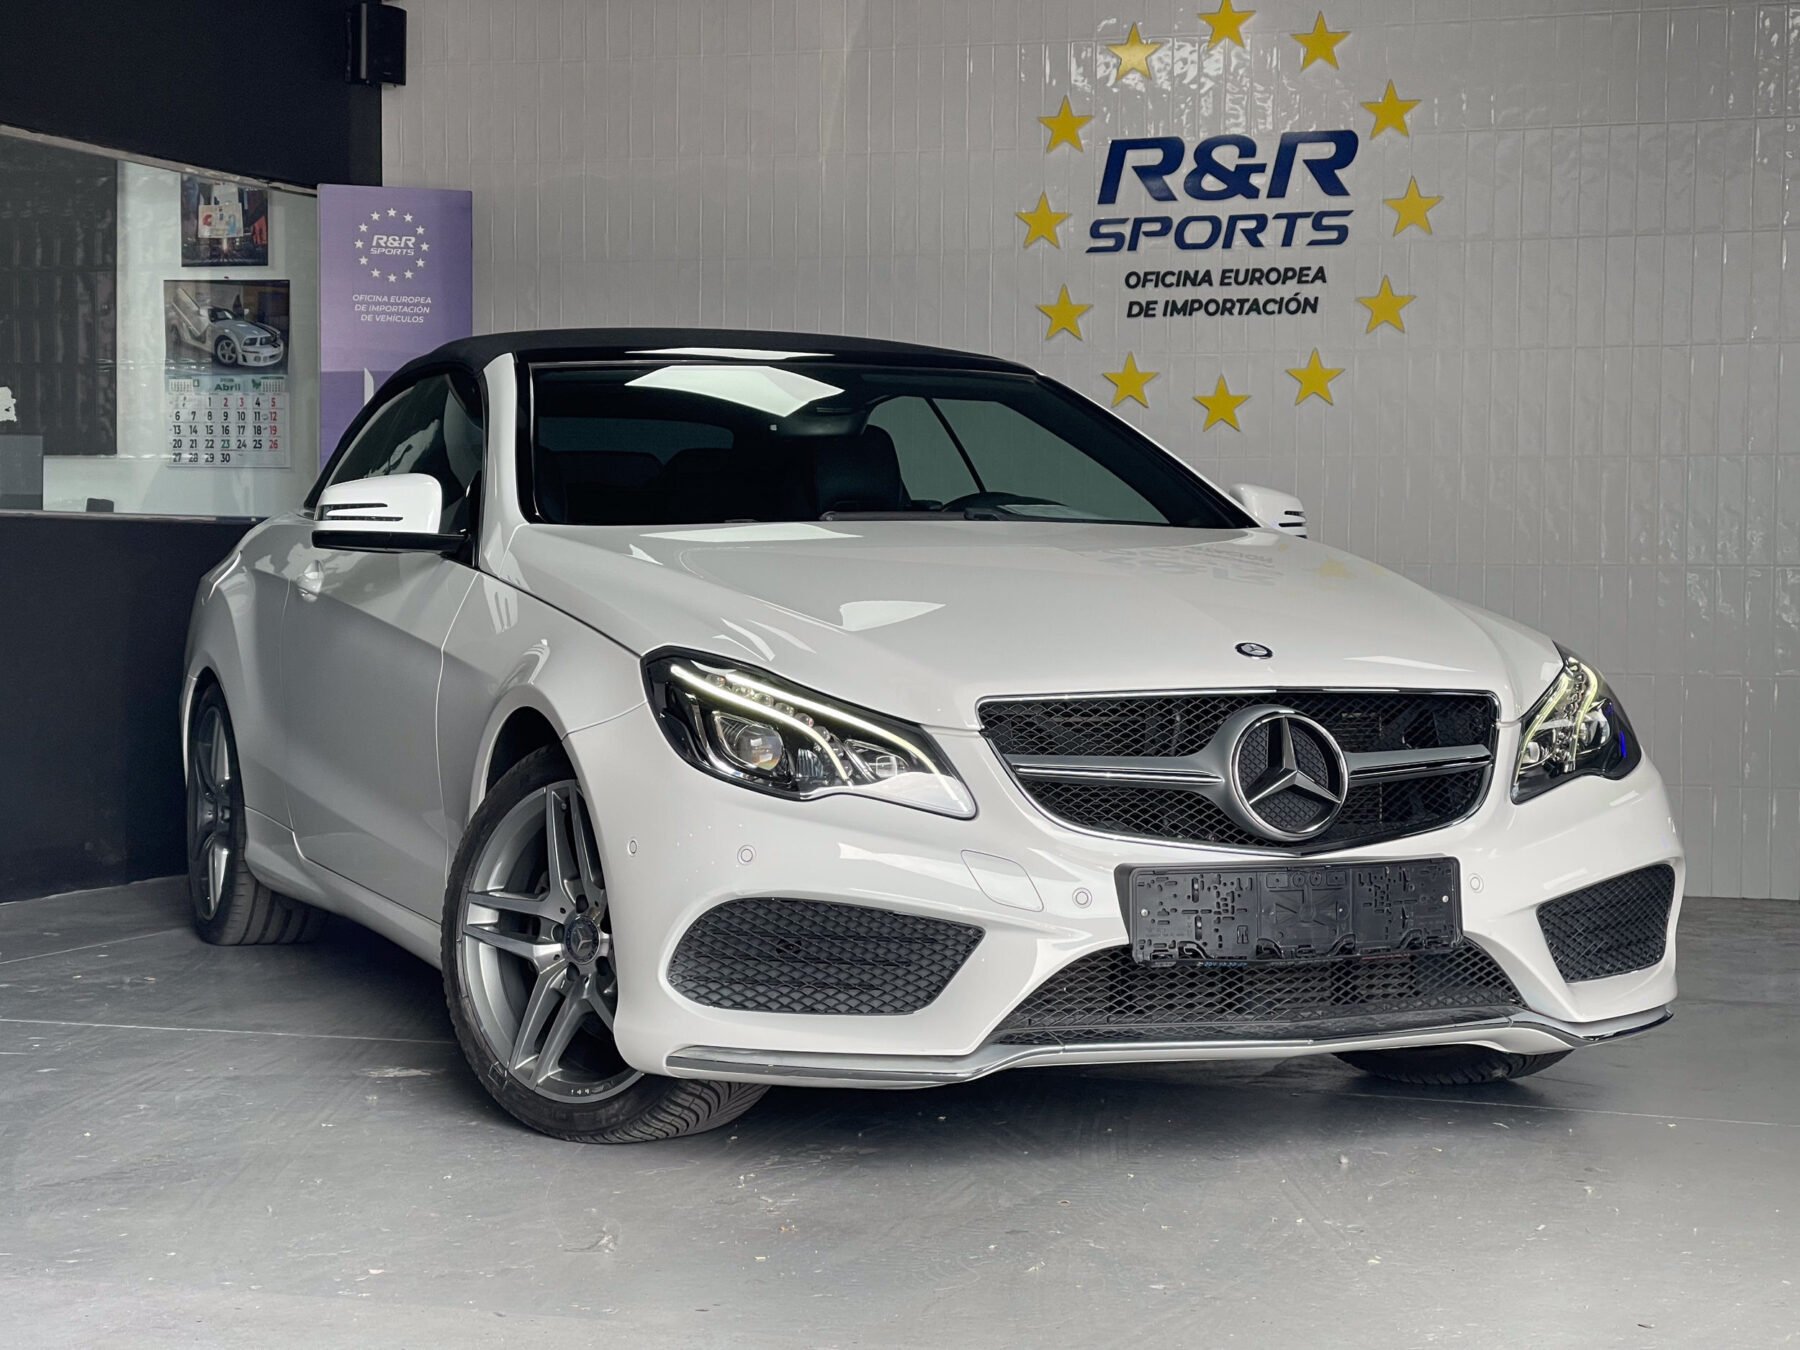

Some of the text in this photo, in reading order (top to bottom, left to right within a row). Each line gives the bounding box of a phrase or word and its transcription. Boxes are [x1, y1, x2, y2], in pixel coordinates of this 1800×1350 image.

[1097, 129, 1359, 205] R&R
[1085, 209, 1354, 254] SPORTS
[372, 234, 416, 248] R&R
[370, 248, 415, 256] SPORTS
[1124, 265, 1328, 289] OFICINA EUROPEA
[352, 294, 432, 304] OFICINA EUROPEA
[355, 304, 430, 313] DE IMPORTACIÓN
[1126, 292, 1319, 319] DE IMPORTACIÓN
[360, 314, 424, 324] DE VEHÍCULOS
[214, 383, 241, 391] Abril
[208, 398, 276, 407] 1 2 3 4 5
[175, 411, 277, 420] 6 7 8 9 10 11 12
[173, 425, 277, 435] 13 14 15 16 17 18 19
[173, 439, 278, 448] 20 21 22 23 24 25 26
[173, 453, 230, 462] 27 28 29 30
